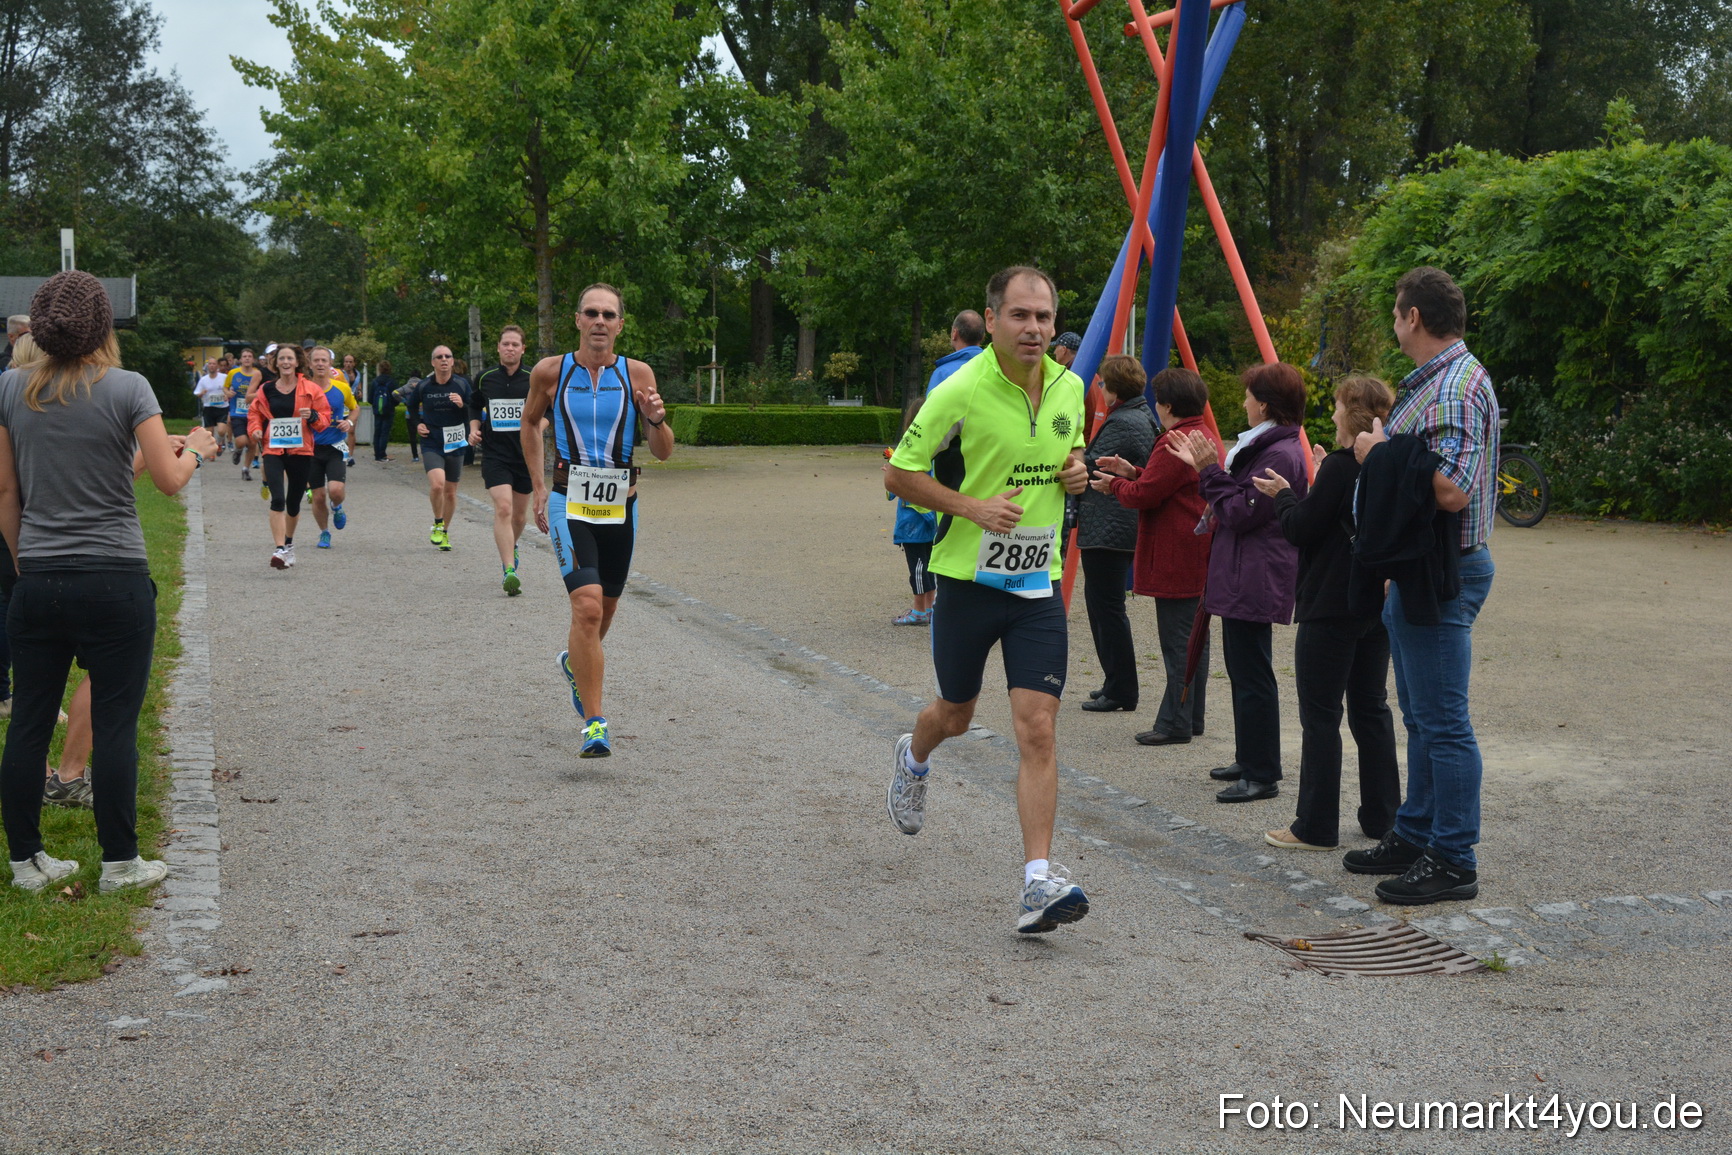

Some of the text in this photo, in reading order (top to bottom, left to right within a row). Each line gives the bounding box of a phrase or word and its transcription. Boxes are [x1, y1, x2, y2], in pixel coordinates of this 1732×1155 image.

[493, 406, 522, 419] 2395
[273, 425, 299, 437] 2334
[1013, 463, 1058, 474] Kloster-
[571, 470, 620, 480] PARTL Neumarkt
[1006, 475, 1060, 488] Apotheke
[581, 480, 618, 502] 140
[582, 506, 611, 516] Thomas
[1014, 533, 1049, 541] Neumarkt
[985, 541, 1050, 572] 2886
[1004, 577, 1025, 589] Rudi
